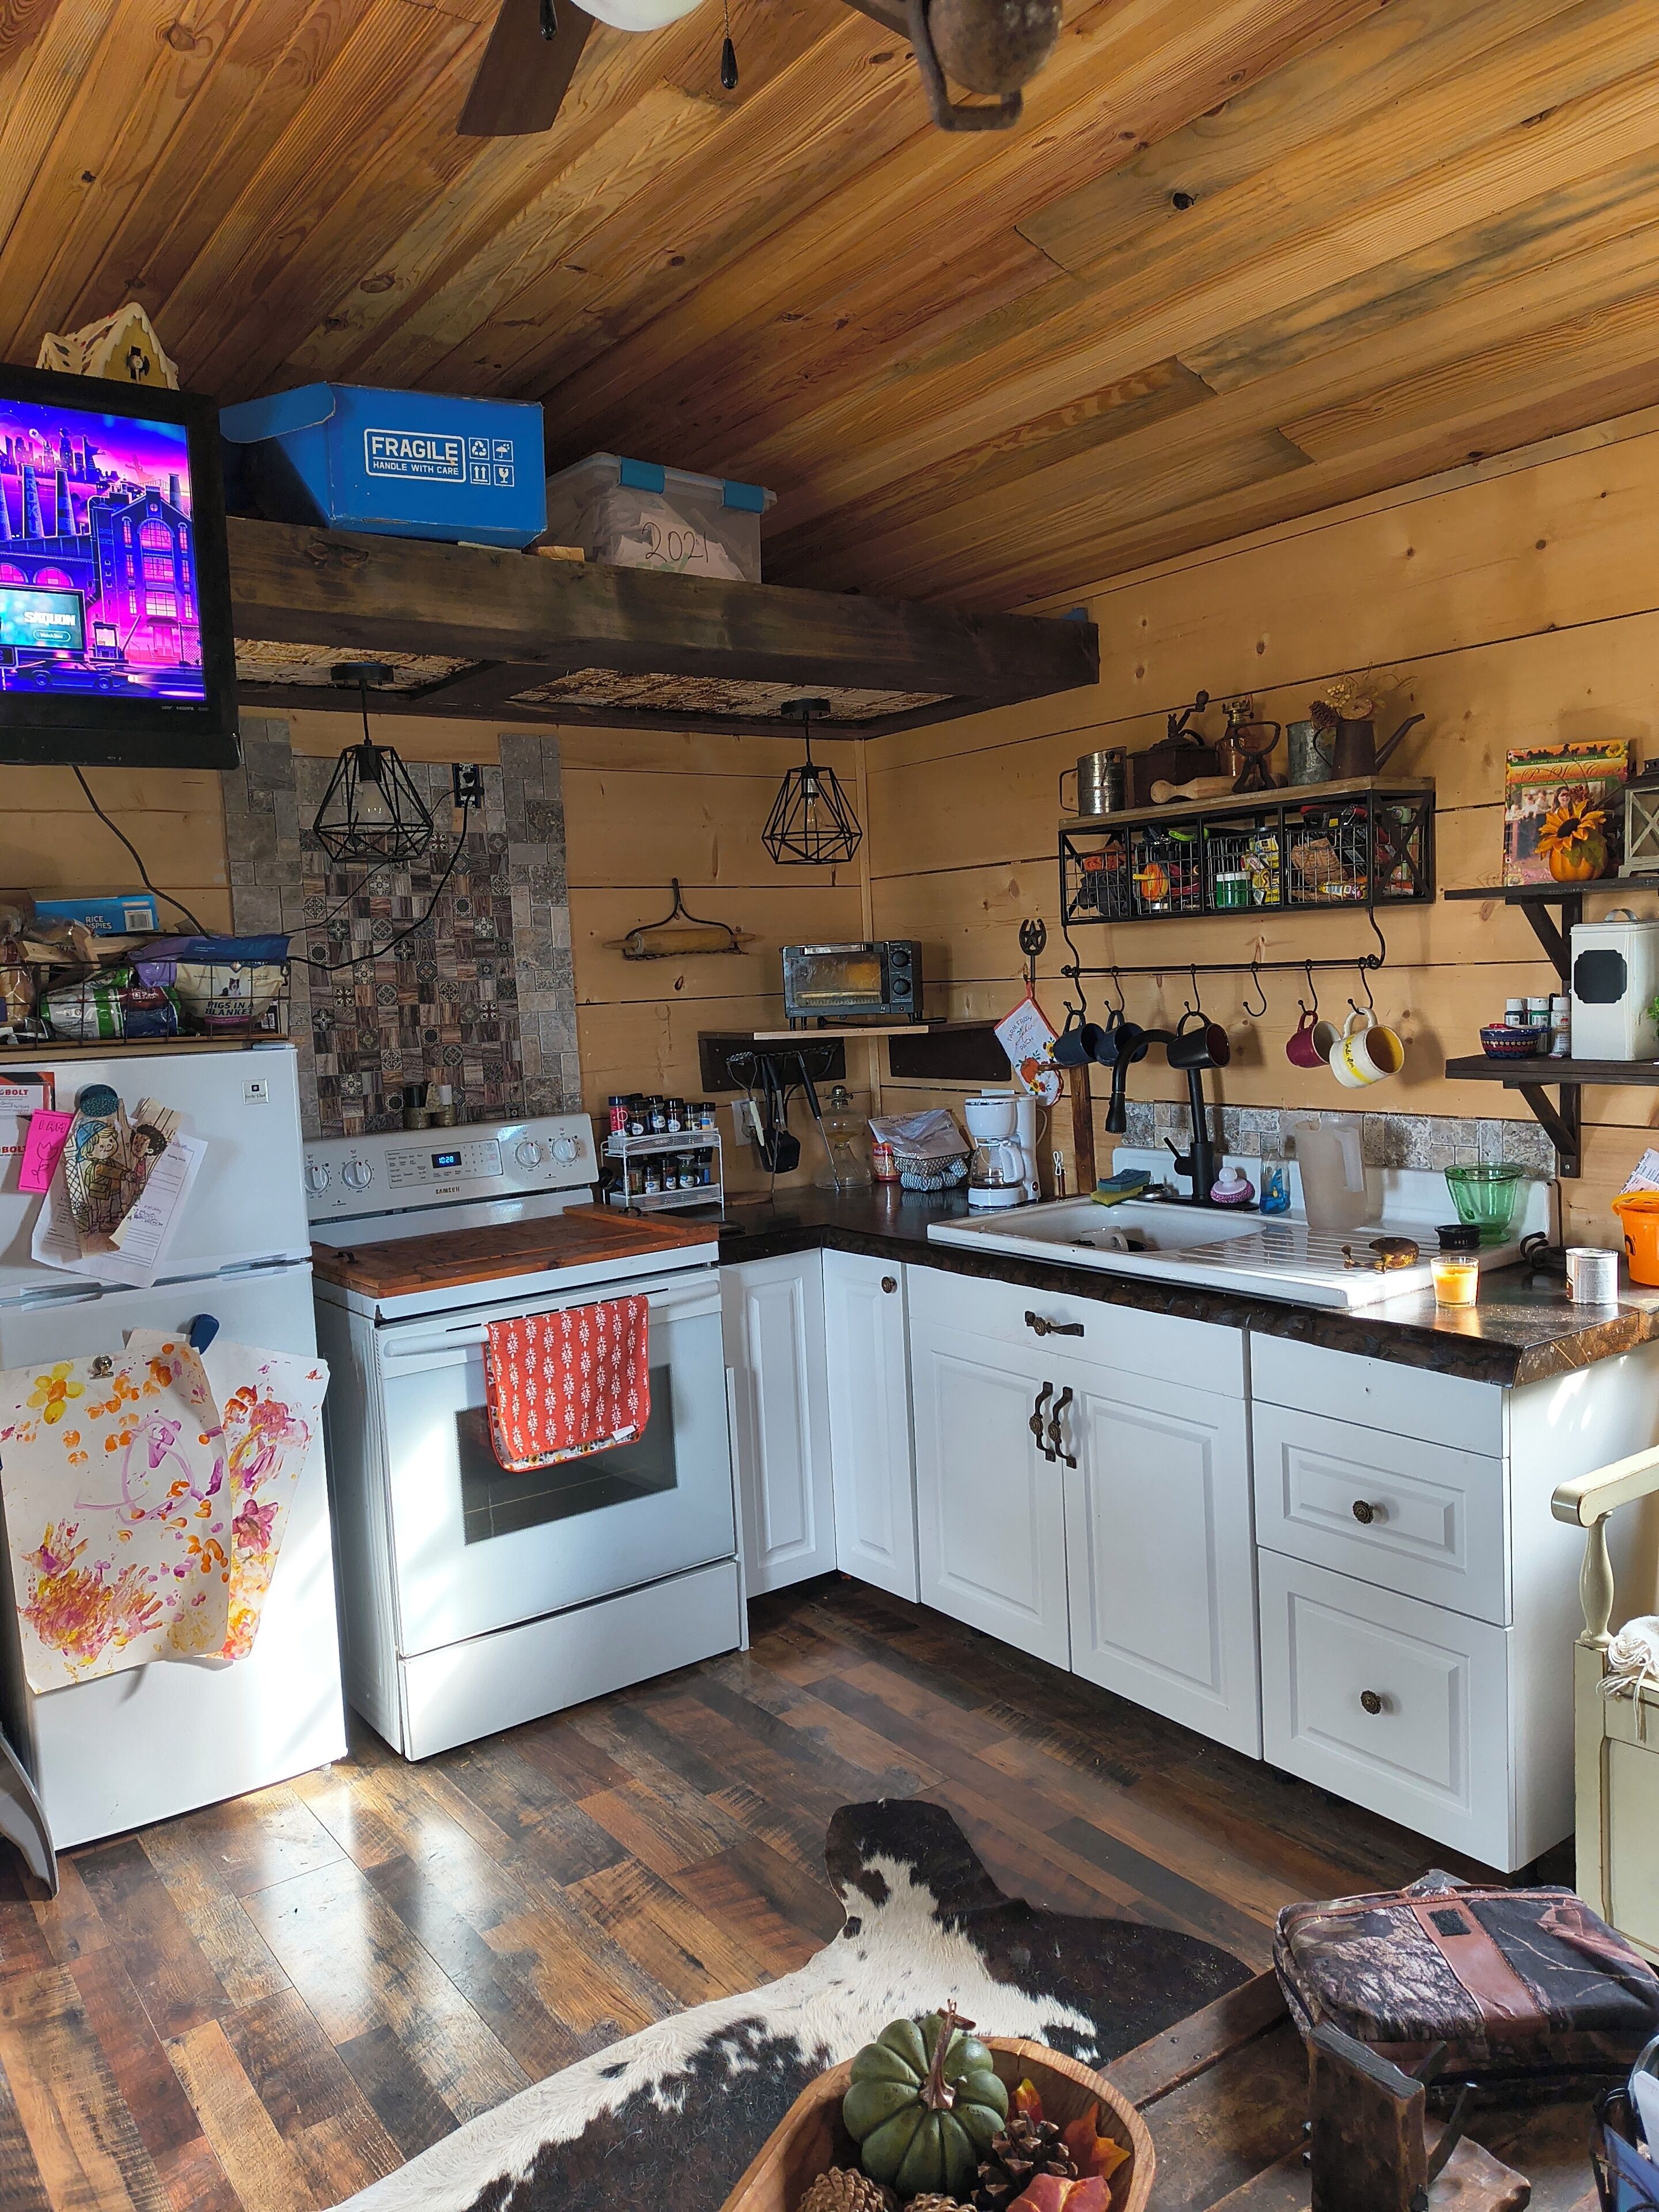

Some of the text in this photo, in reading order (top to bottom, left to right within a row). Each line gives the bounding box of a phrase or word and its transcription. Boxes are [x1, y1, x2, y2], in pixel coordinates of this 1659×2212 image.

[372, 436, 459, 461] FRAGILE
[373, 461, 459, 475] HANDLE WITH CARE
[642, 522, 709, 563] 2021
[38, 1119, 67, 1134] I AM
